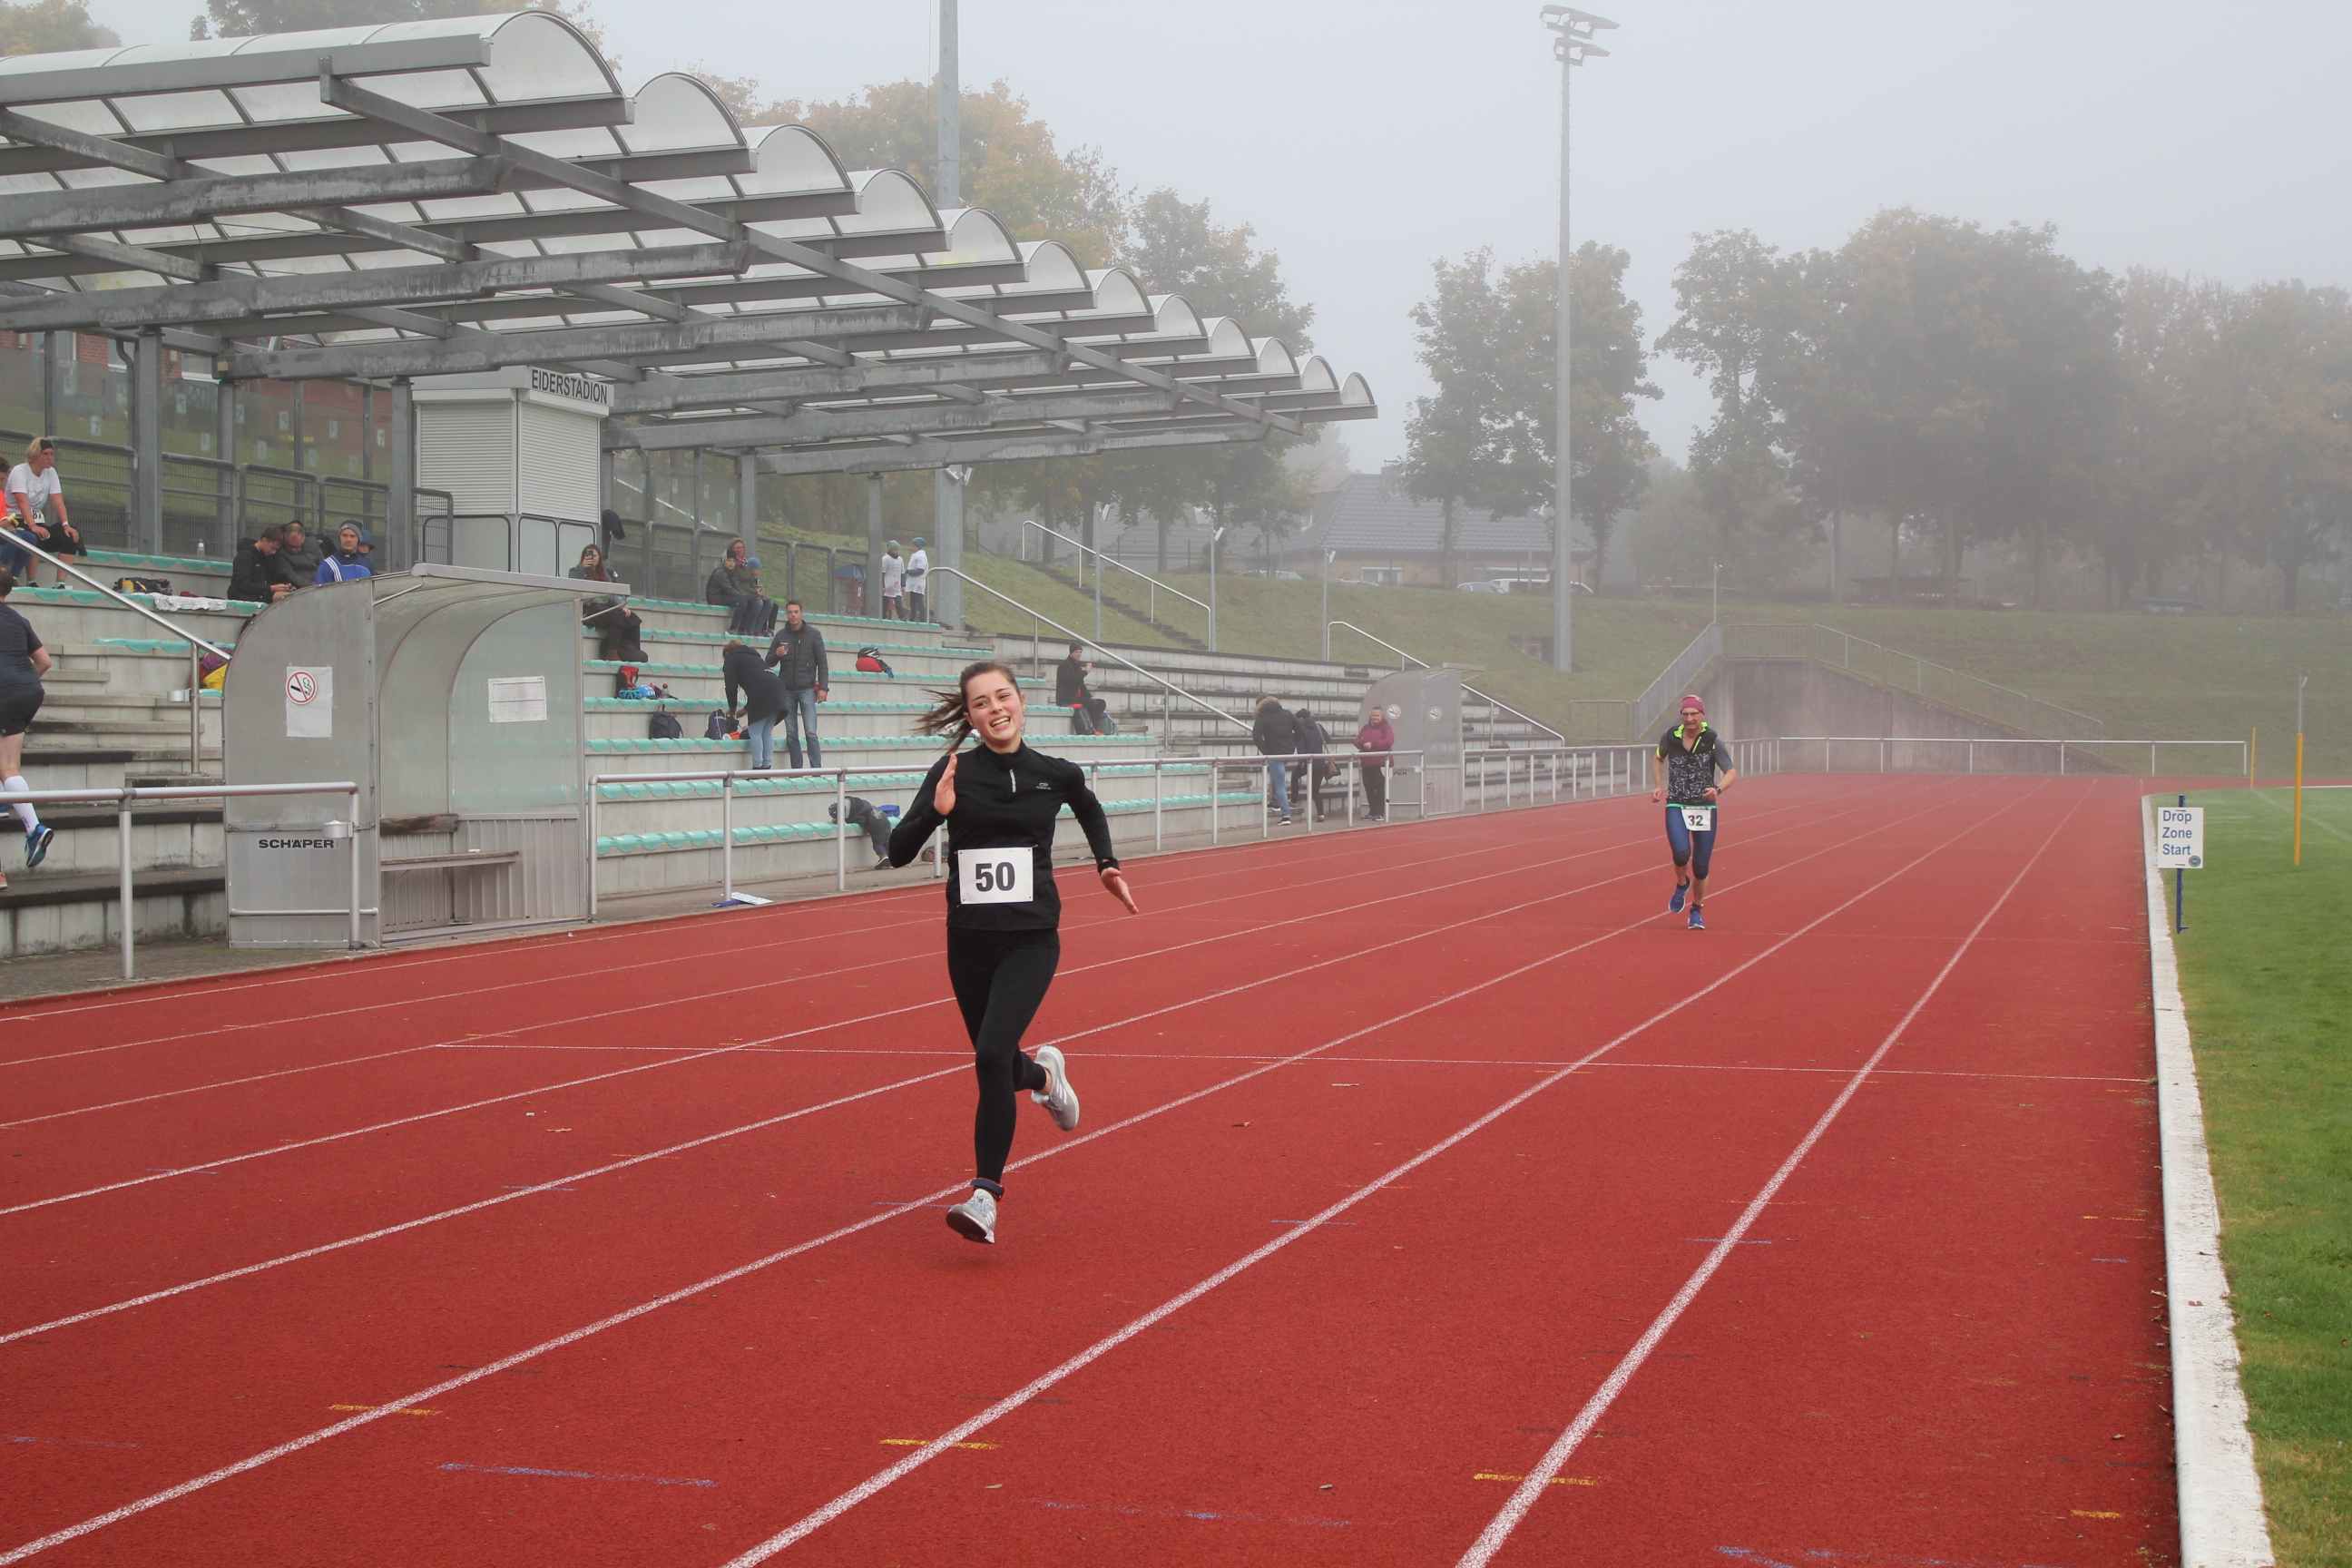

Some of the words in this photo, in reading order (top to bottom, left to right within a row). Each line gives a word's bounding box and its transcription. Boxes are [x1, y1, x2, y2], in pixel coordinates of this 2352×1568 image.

[532, 369, 608, 404] EIDERSTADION
[1688, 815, 1704, 827] 32
[2163, 810, 2192, 824] Drop
[2162, 827, 2192, 838] Zone
[2162, 843, 2191, 855] Start
[975, 861, 1015, 892] 50
